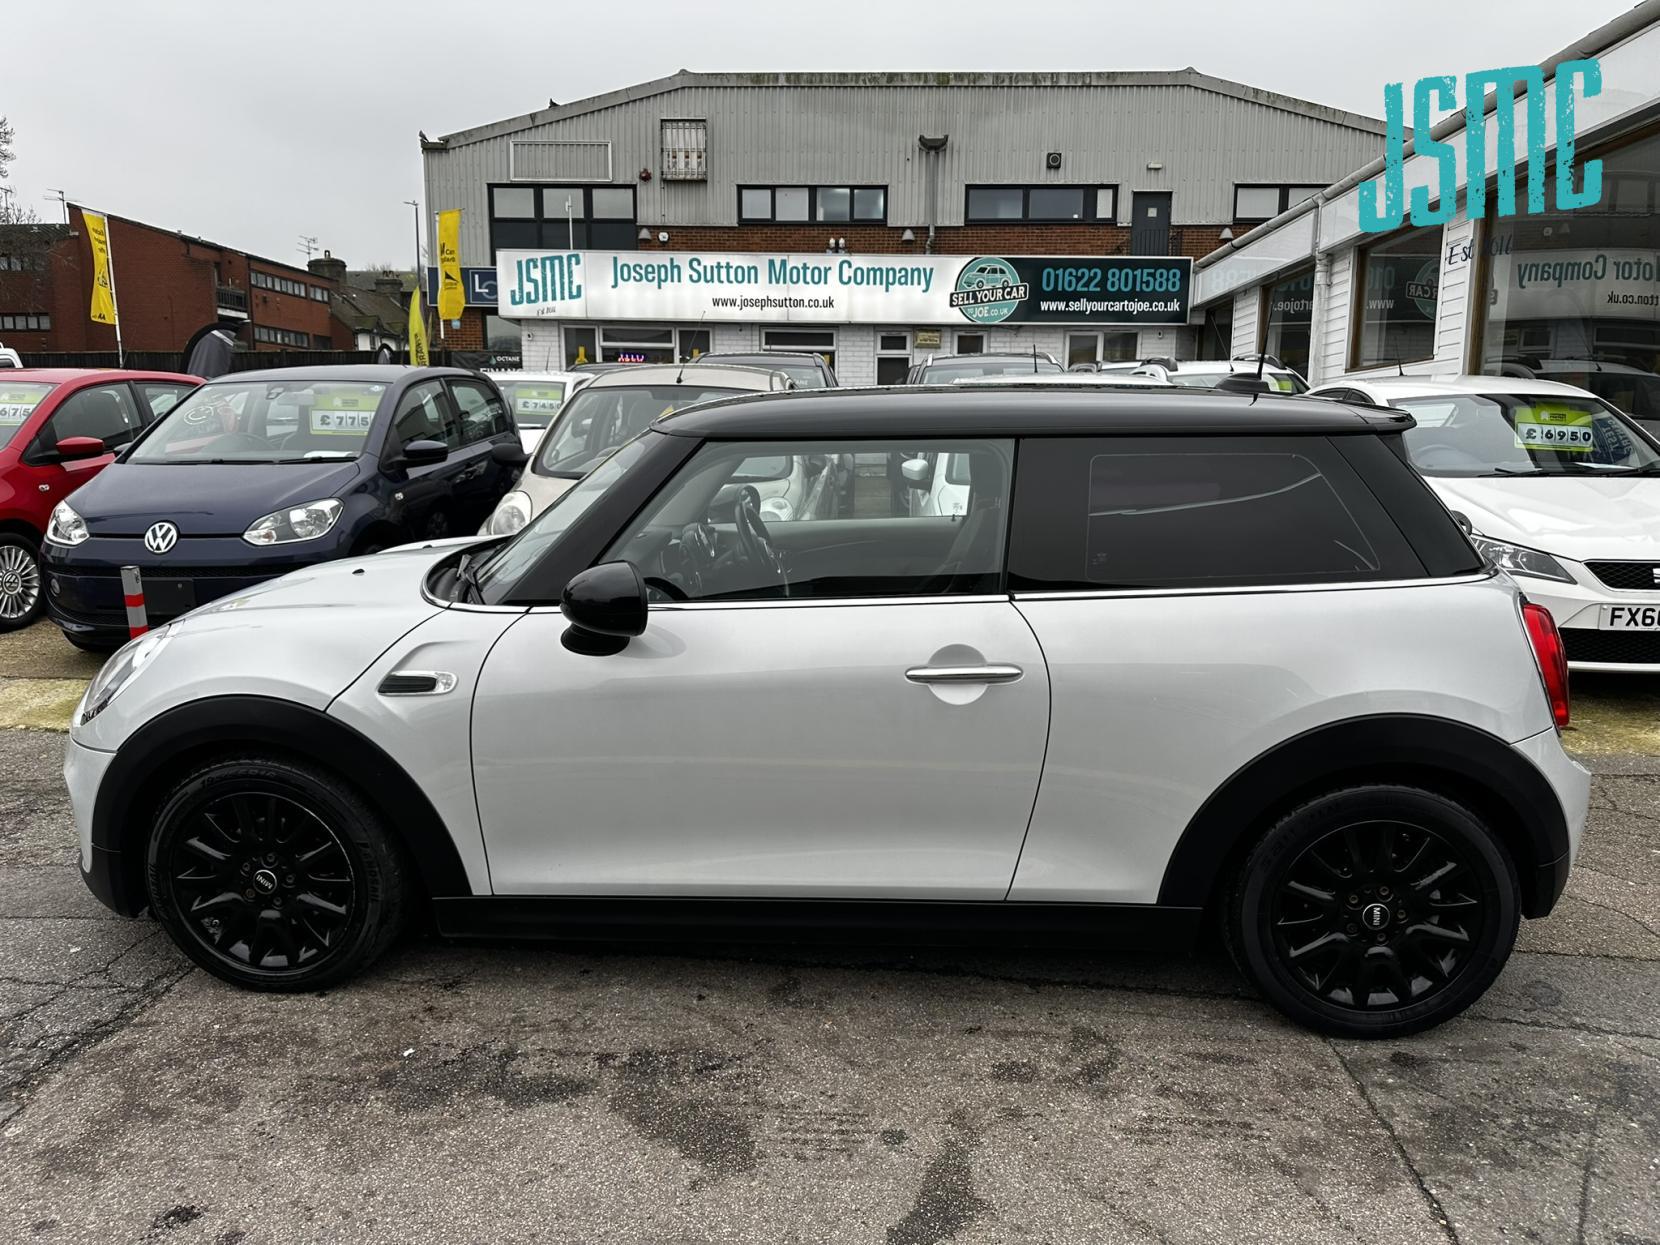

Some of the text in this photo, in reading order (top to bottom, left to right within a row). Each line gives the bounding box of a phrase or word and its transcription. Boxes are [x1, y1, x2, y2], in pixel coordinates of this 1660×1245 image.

[510, 253, 582, 306] JSMC
[611, 256, 934, 293] Joseph Sutton Motor Company
[1042, 268, 1181, 292] 01622 801588
[712, 295, 834, 310] www.josephsutton.co.uk
[952, 286, 1025, 306] SELL YOUR CAR
[1040, 298, 1180, 315] www.sellyourcartojoe.co.uk
[1610, 607, 1660, 627] FX6
[256, 874, 273, 889] MINI
[1373, 907, 1381, 926] MINI
